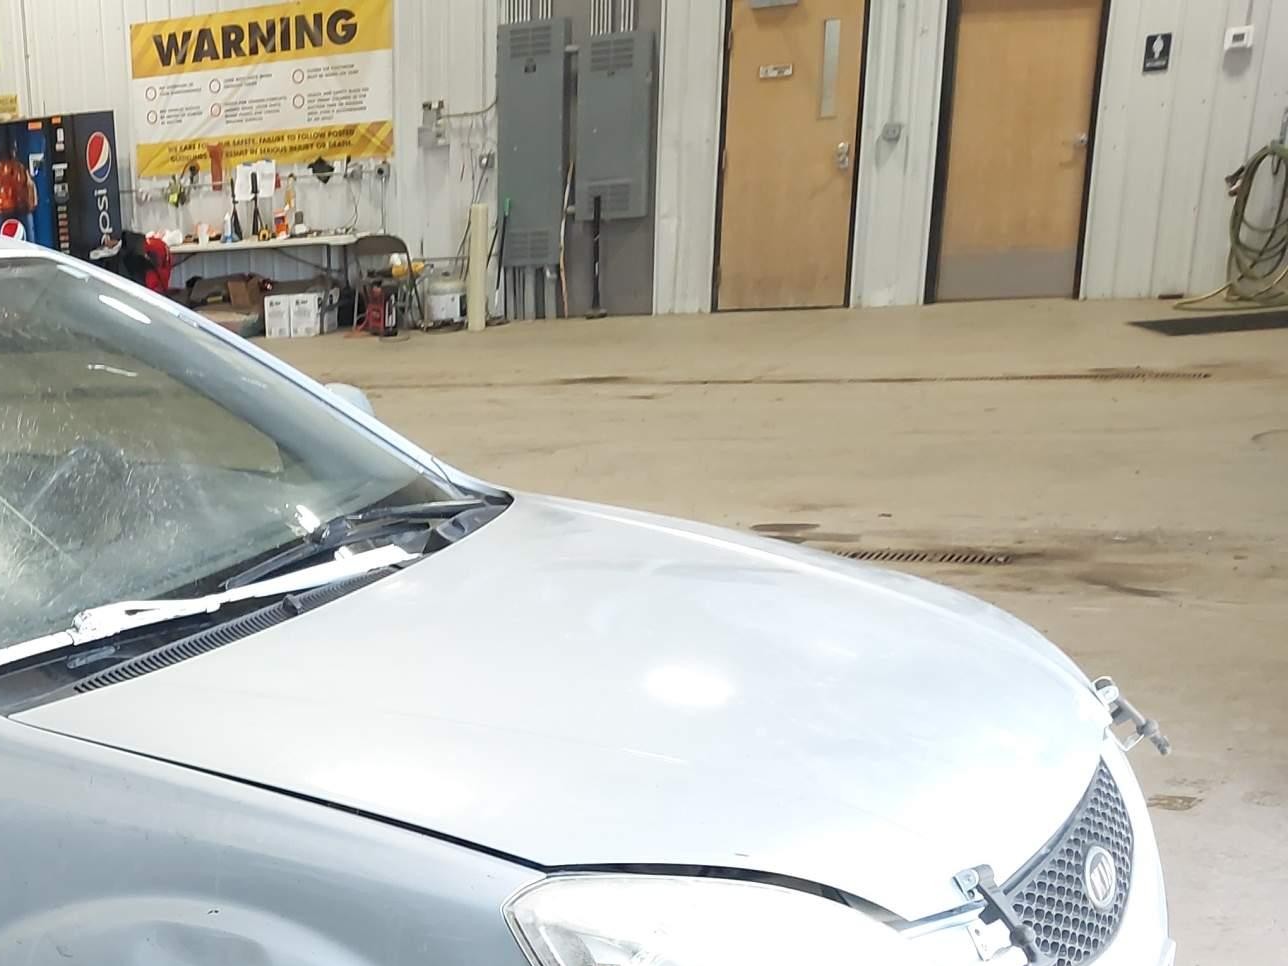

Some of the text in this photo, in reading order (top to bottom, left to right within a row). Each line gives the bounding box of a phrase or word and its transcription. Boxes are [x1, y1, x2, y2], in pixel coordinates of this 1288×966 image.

[153, 9, 358, 67] WARNING
[287, 133, 295, 141] TO
[298, 130, 326, 140] FOLLOW
[328, 127, 355, 138] POSTED
